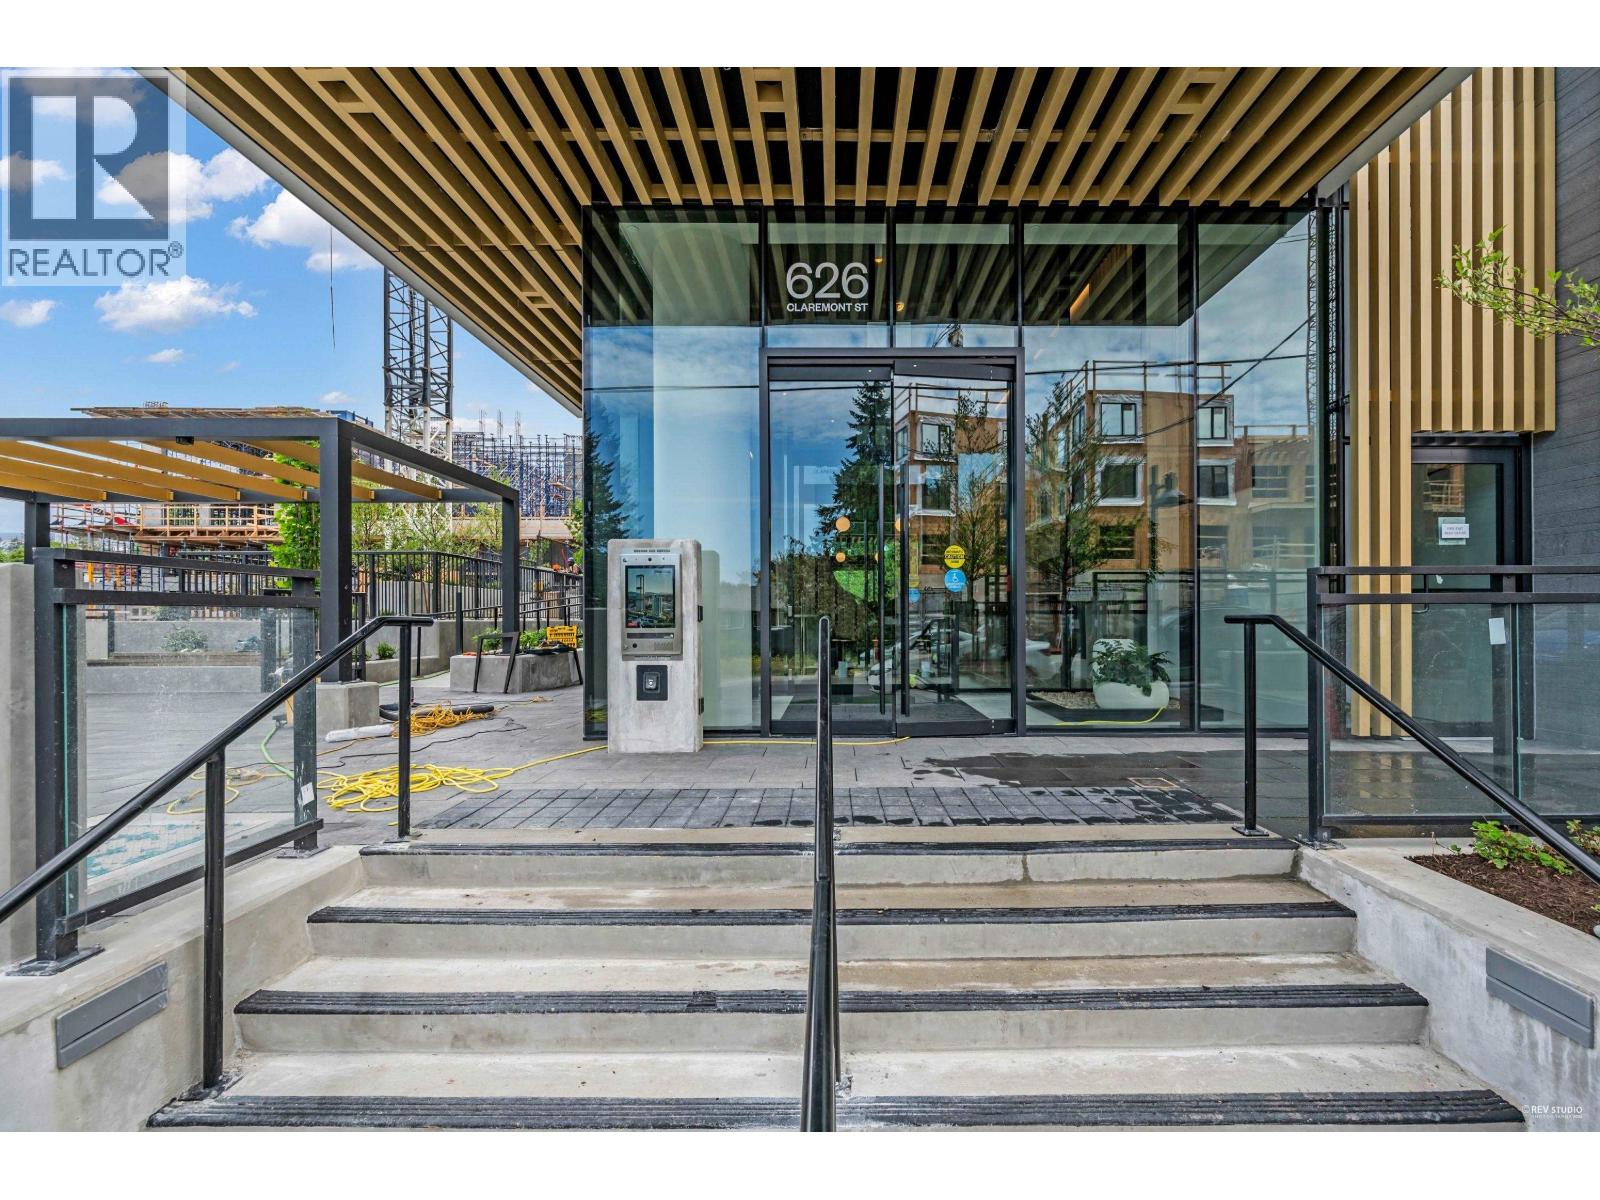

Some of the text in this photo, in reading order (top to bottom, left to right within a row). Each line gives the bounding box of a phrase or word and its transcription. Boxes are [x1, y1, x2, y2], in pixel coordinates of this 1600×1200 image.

[786, 262, 869, 299] 626
[786, 302, 869, 312] CLAREMONT ST
